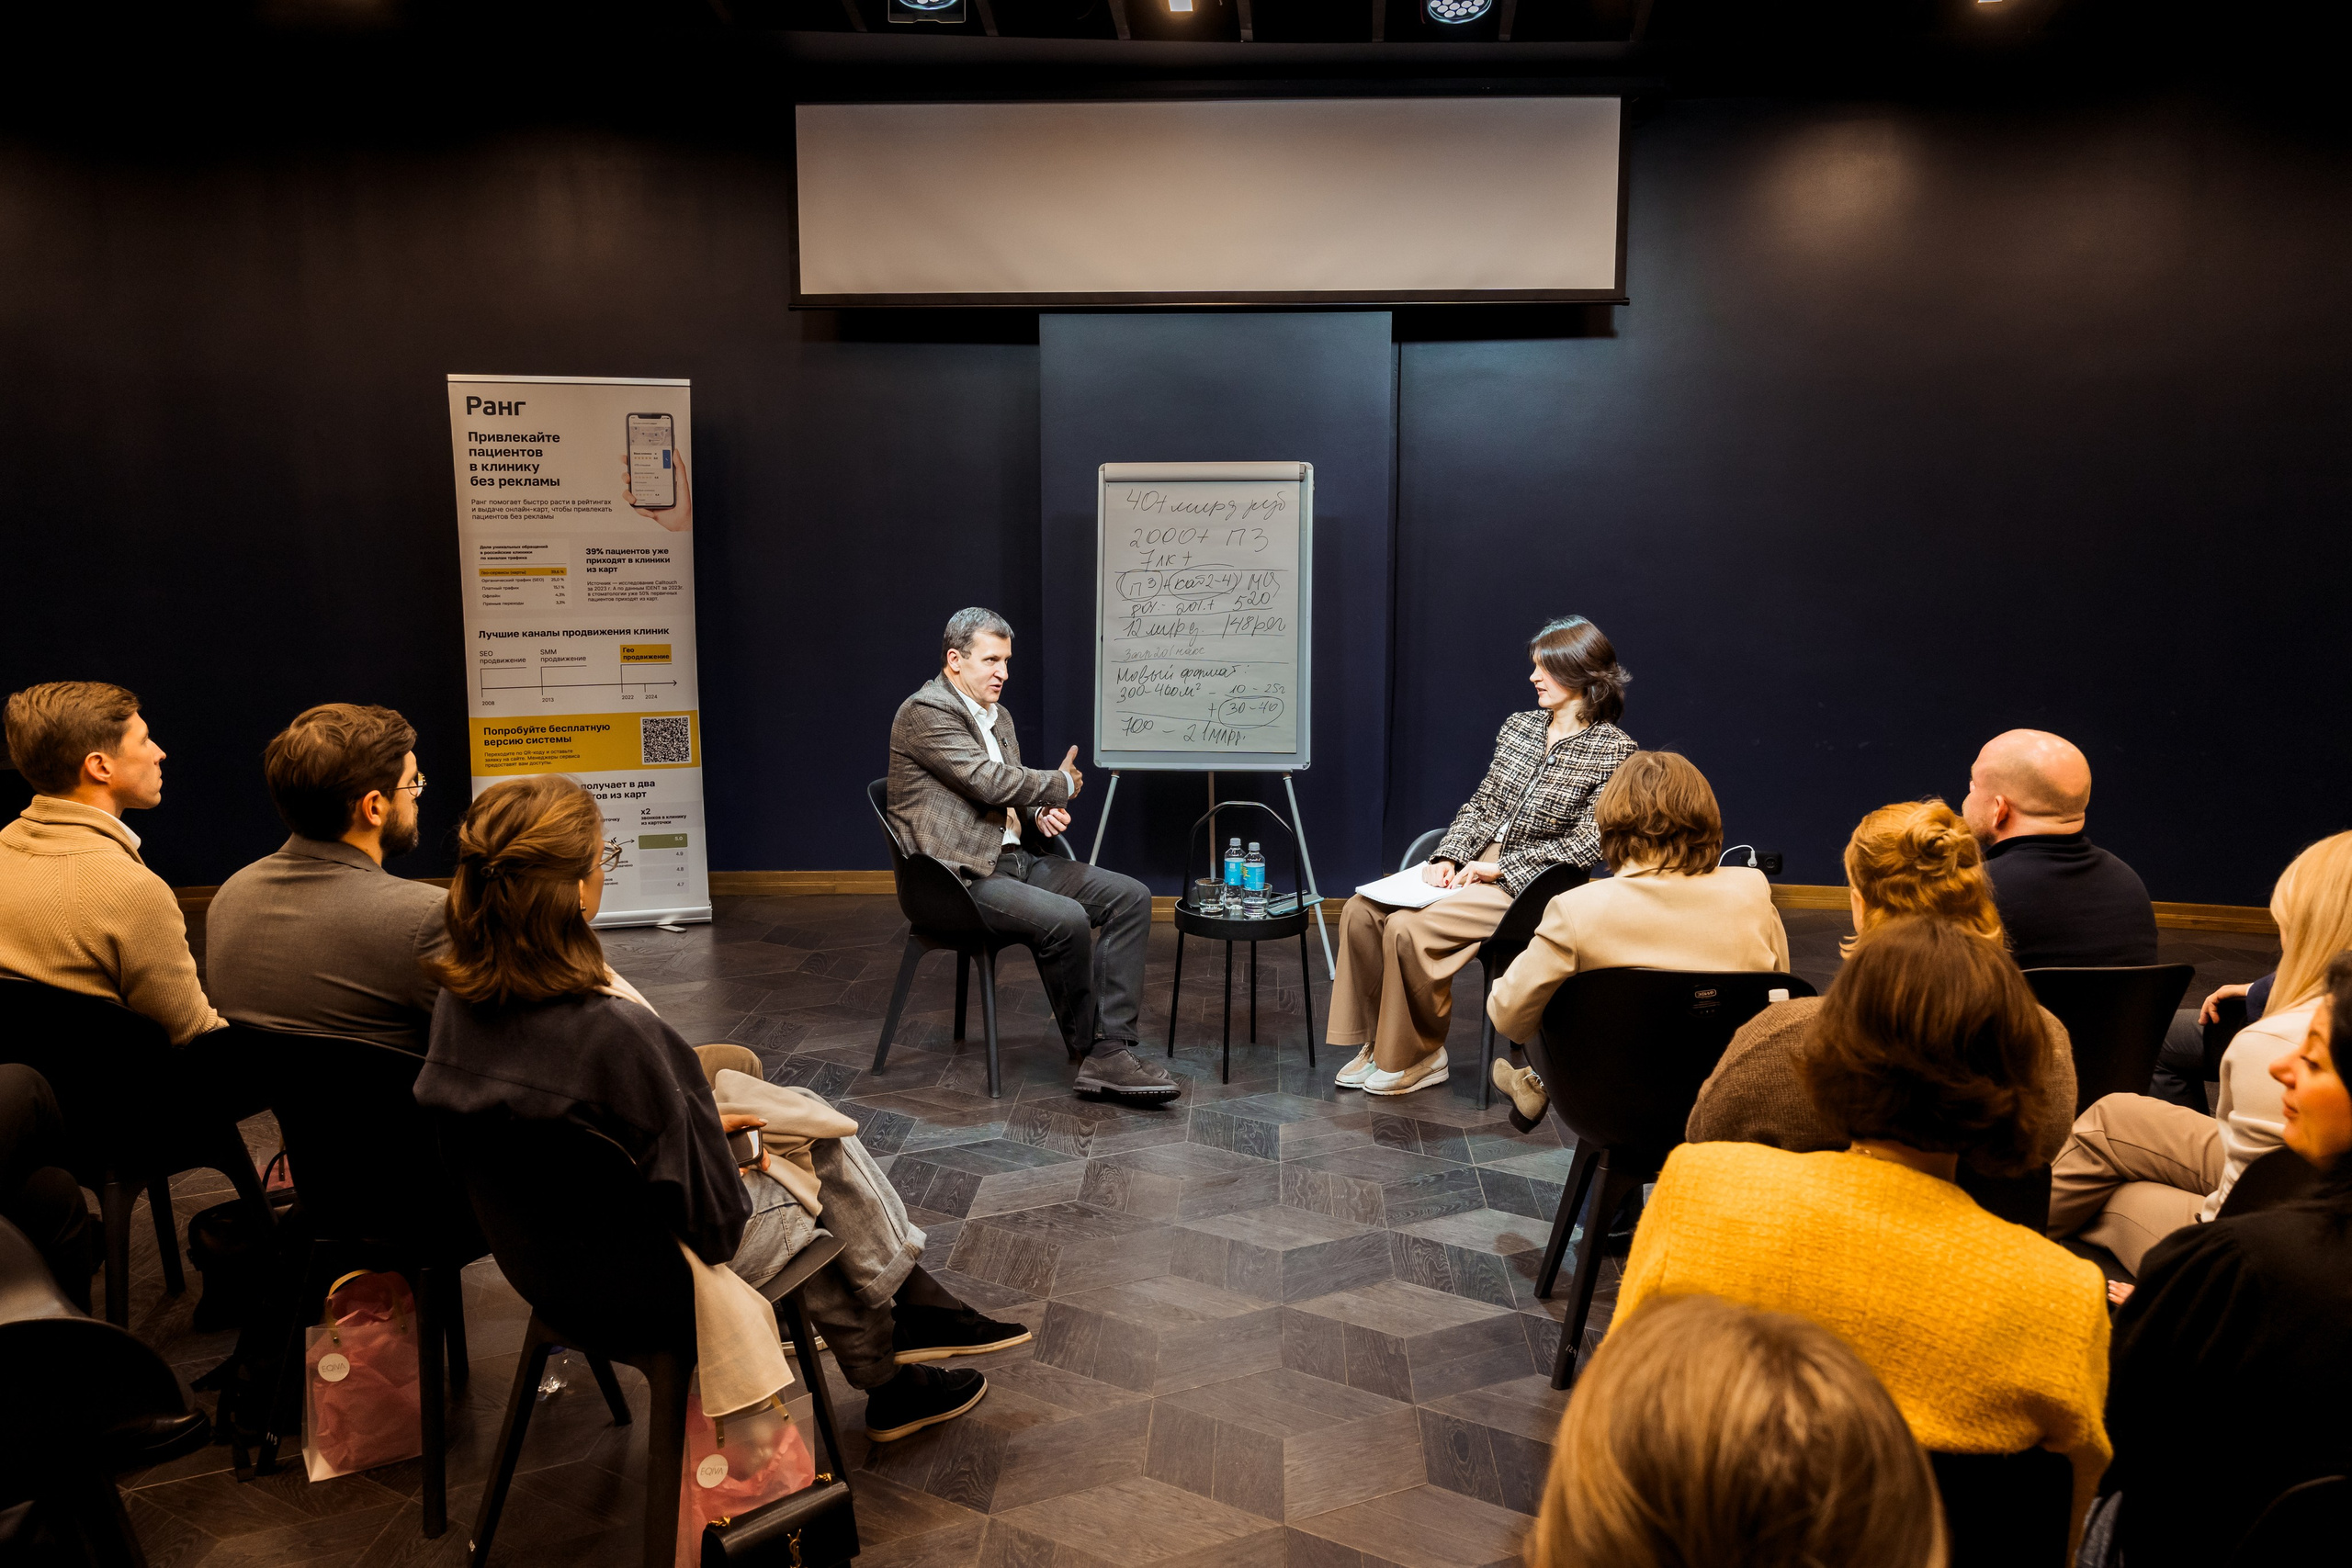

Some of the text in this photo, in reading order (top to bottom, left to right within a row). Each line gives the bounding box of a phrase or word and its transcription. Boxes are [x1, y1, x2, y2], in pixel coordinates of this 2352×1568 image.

[466, 396, 526, 415] Ранг
[468, 432, 560, 443] Привлекайте
[469, 448, 543, 458] пациентов
[470, 463, 540, 474] в клинику
[470, 476, 560, 488] без рекламы
[479, 627, 669, 639] Лучшие каналы продвижения клиник
[484, 724, 610, 736] Попробуйте бесплатную
[484, 736, 571, 747] версию системы
